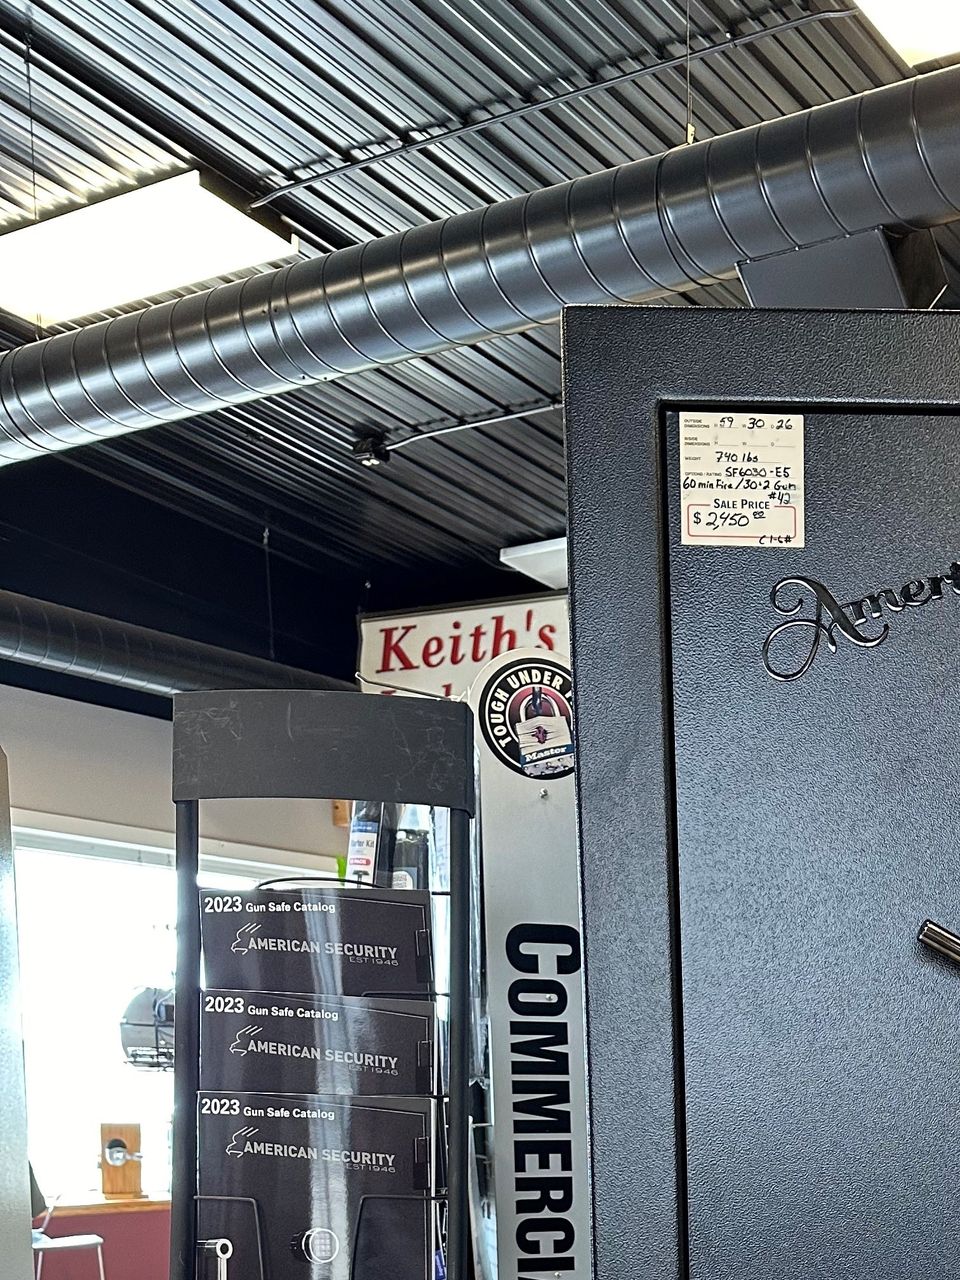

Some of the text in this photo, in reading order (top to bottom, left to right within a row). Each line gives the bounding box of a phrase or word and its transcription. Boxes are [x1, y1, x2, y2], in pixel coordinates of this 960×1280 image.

[719, 416, 734, 429] 59
[747, 417, 765, 430] 30
[776, 418, 793, 430] 26
[715, 451, 738, 463] 740
[683, 477, 697, 490] 60
[698, 480, 714, 489] min
[714, 499, 770, 509] SALE PRICE
[693, 511, 701, 525] $
[490, 669, 563, 748] TOUGH UNDER
[204, 896, 336, 913] 2023 Gun Safe Catalog
[248, 937, 397, 959] AMERICAN SECURITY
[371, 958, 399, 967] 1946
[205, 996, 338, 1021] 2023 Gun Safe Catalog
[248, 1040, 397, 1069] AMERICAN SECURITY
[371, 1067, 399, 1075] 1946
[201, 1098, 335, 1120] 2023 Gun Safe Catalog
[244, 1141, 395, 1166] AMERICAN SECURITY
[369, 1164, 396, 1173] 1946
